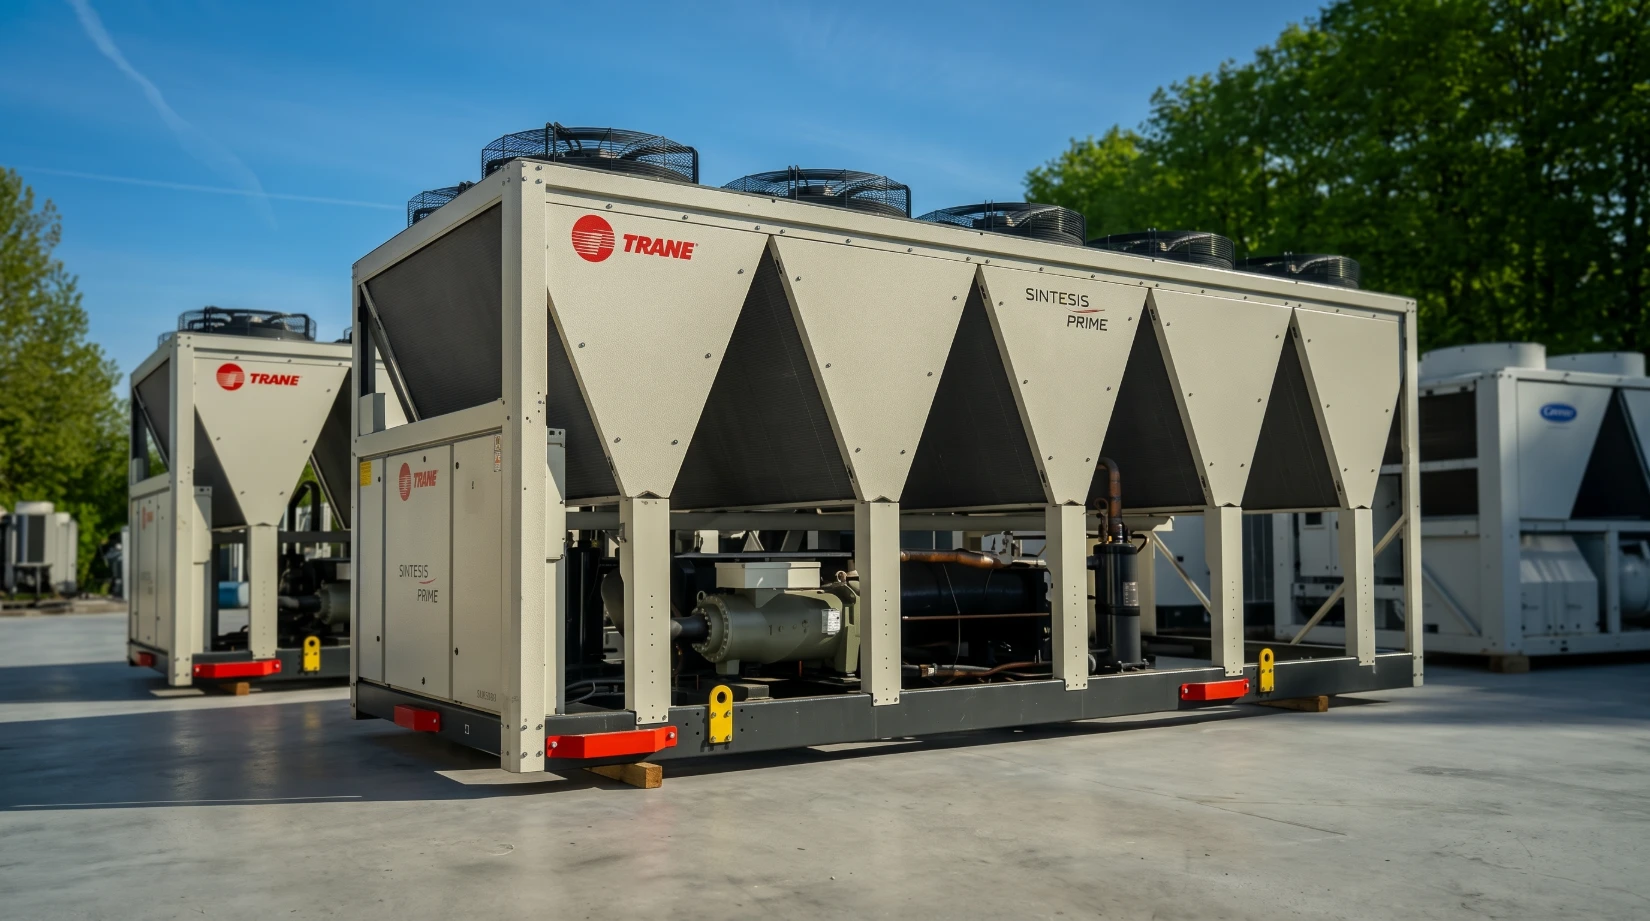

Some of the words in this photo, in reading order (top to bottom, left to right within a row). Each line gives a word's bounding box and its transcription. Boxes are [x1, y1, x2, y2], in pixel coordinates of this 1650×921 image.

[623, 233, 695, 260] TRANE
[1025, 287, 1089, 307] SINTESIS
[1066, 315, 1108, 331] PRIME
[250, 373, 300, 386] TRANE
[413, 470, 437, 488] TRANE
[399, 564, 429, 578] SINTESIS
[417, 588, 438, 603] PRIME
